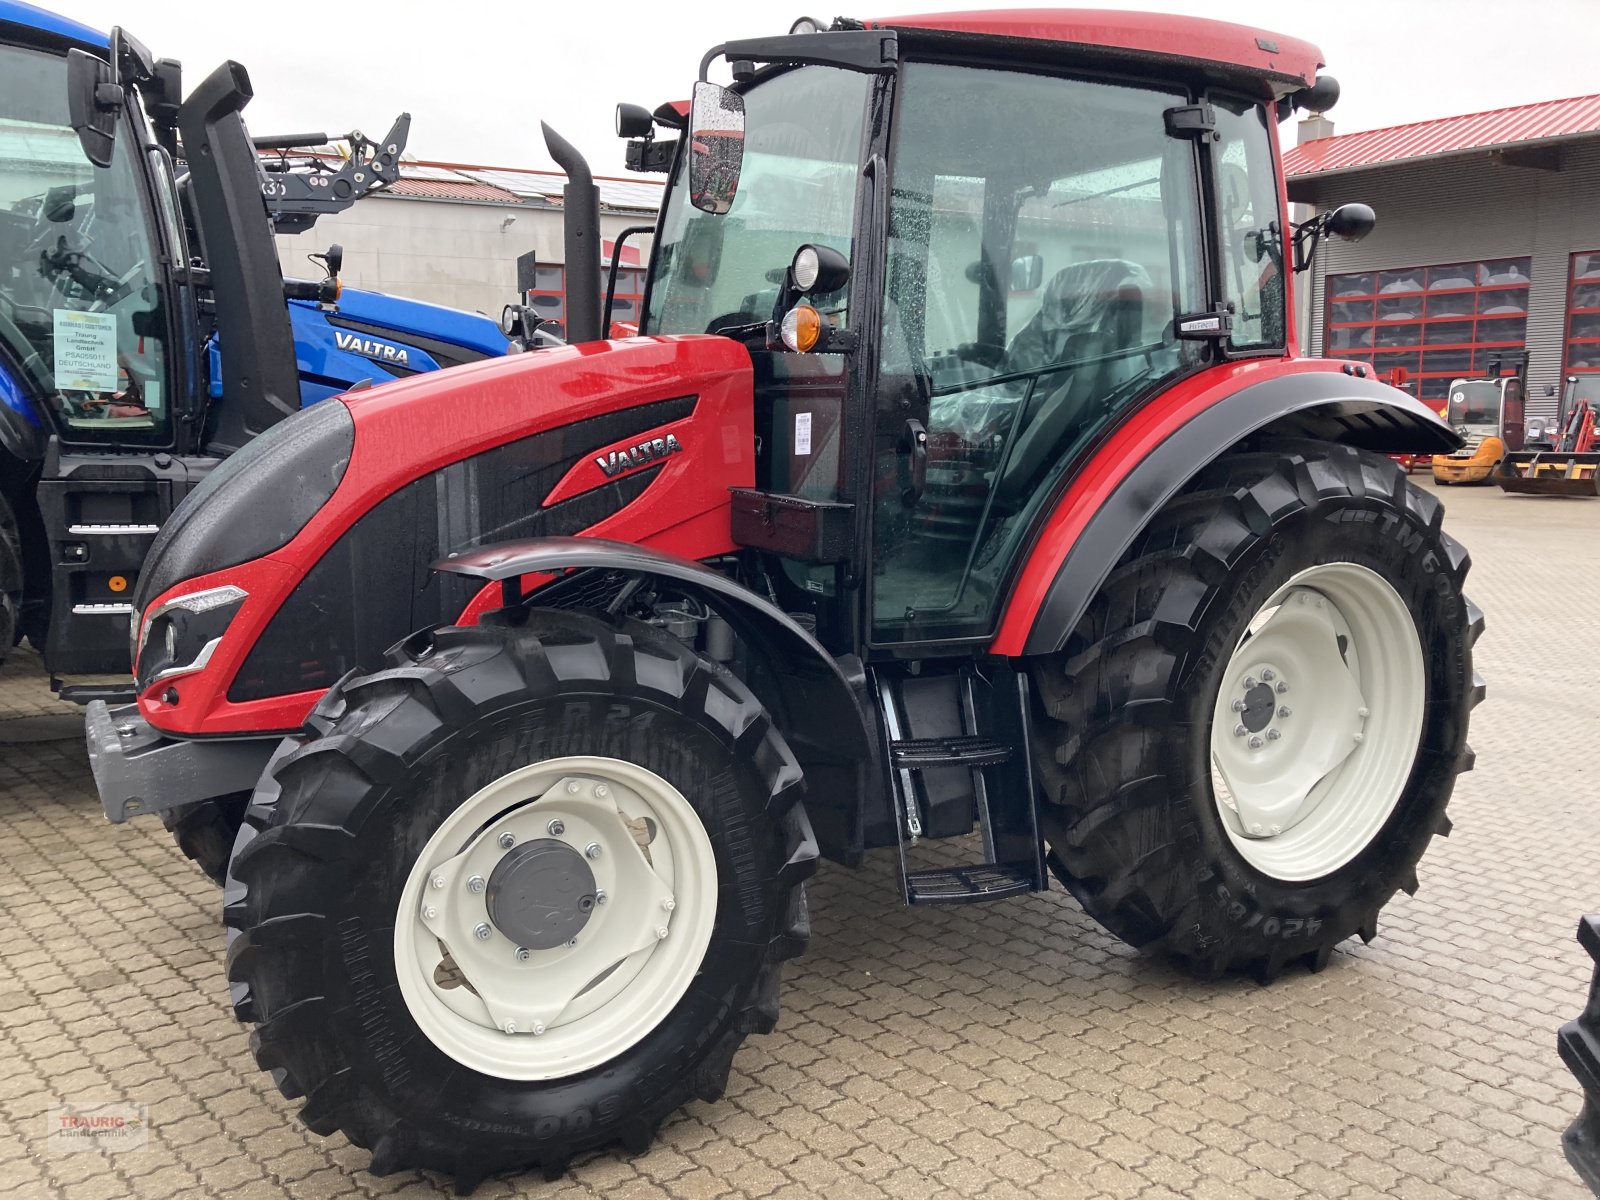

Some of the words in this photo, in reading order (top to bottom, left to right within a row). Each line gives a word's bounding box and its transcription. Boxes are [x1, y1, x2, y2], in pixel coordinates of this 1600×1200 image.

[335, 331, 408, 364] VALTRA
[58, 360, 111, 369] DEUTSCHLAND
[595, 433, 682, 477] VALTRA
